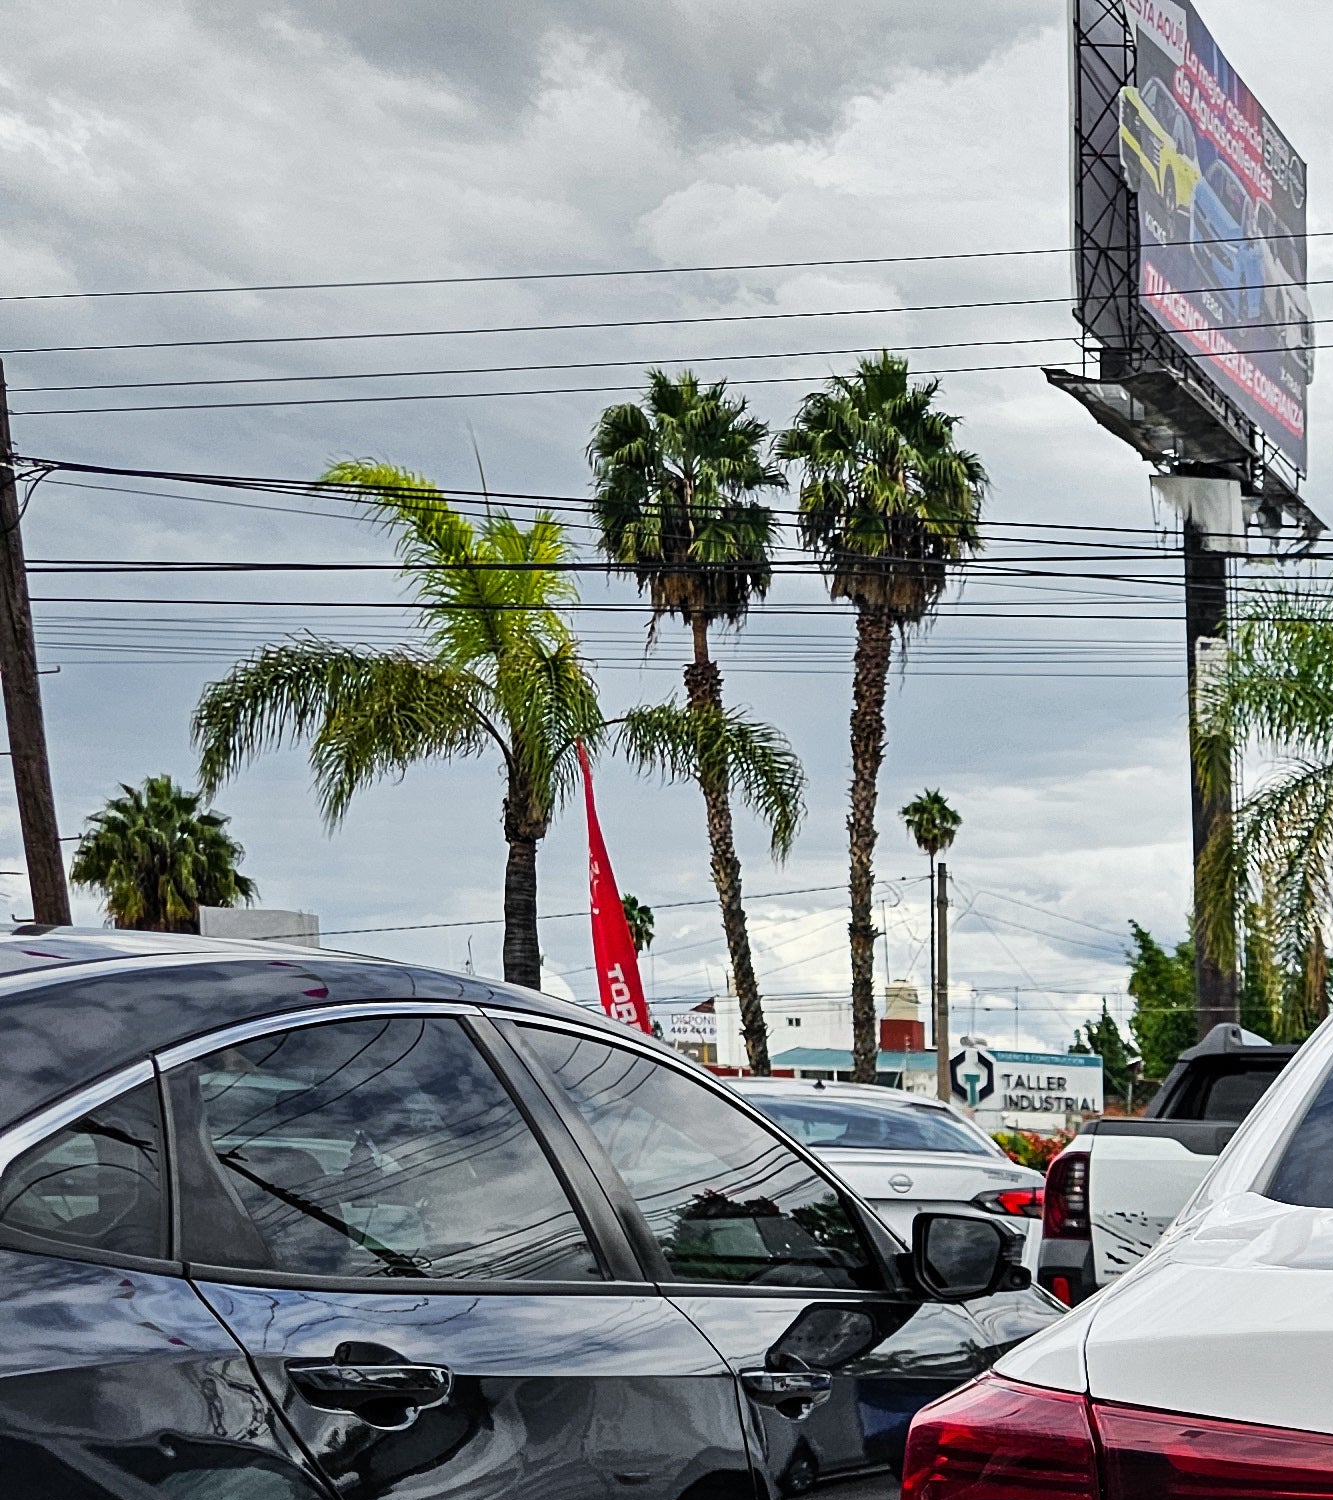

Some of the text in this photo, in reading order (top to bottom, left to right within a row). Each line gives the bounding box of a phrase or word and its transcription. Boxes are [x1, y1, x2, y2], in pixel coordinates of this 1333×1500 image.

[1175, 67, 1191, 104] de
[1226, 99, 1263, 155] agencia
[1146, 262, 1164, 301] TU
[608, 962, 643, 1032] TOR
[1002, 1073, 1067, 1092] TALLER
[1003, 1094, 1100, 1113] INDUSTRIAL
